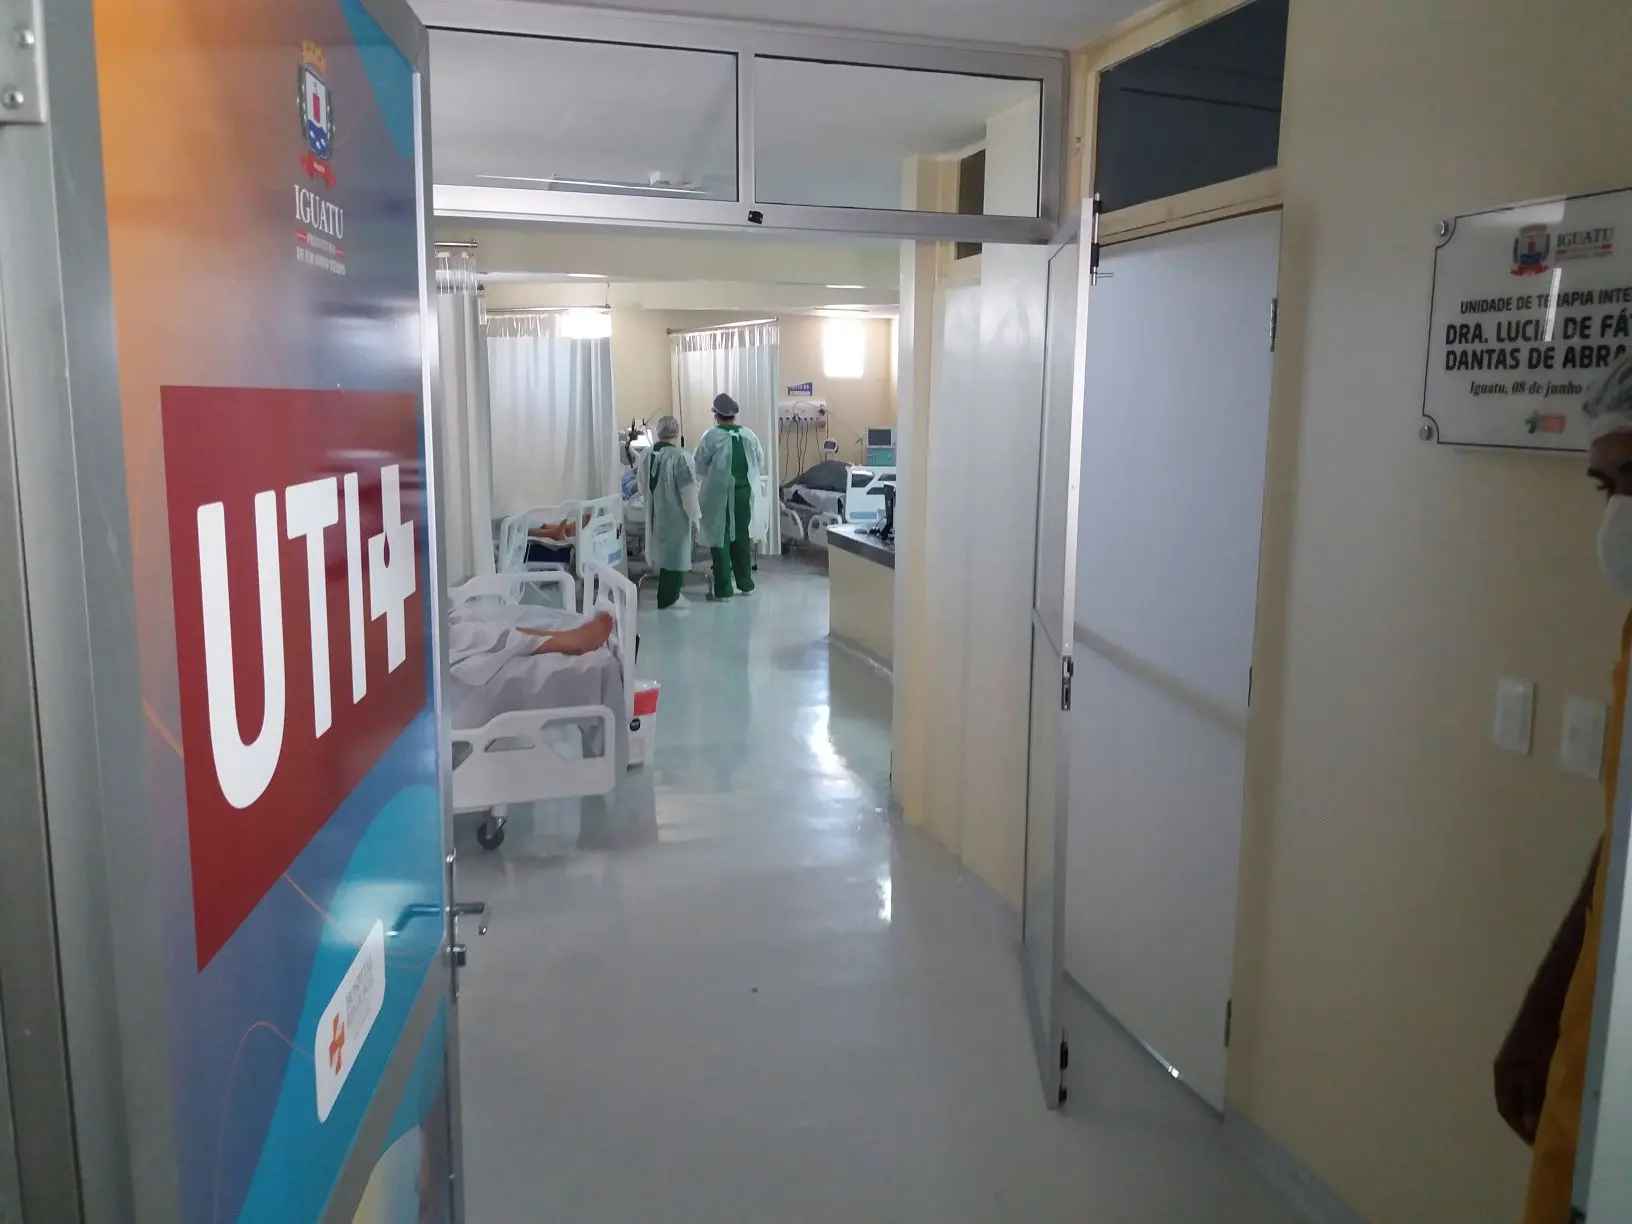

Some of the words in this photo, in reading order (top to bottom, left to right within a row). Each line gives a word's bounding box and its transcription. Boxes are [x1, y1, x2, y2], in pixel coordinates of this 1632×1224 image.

[294, 184, 344, 240] IGUATU
[1557, 227, 1614, 247] IGUATU
[1460, 296, 1513, 314] UNIDADE
[1516, 296, 1533, 311] DE
[1445, 322, 1489, 345] DRA.
[1562, 315, 1592, 341] DE
[1445, 347, 1521, 371] DANTAS
[1527, 346, 1556, 370] DE
[1470, 380, 1508, 398] Iguatu,
[1528, 380, 1543, 394] de
[1544, 380, 1583, 399] junho
